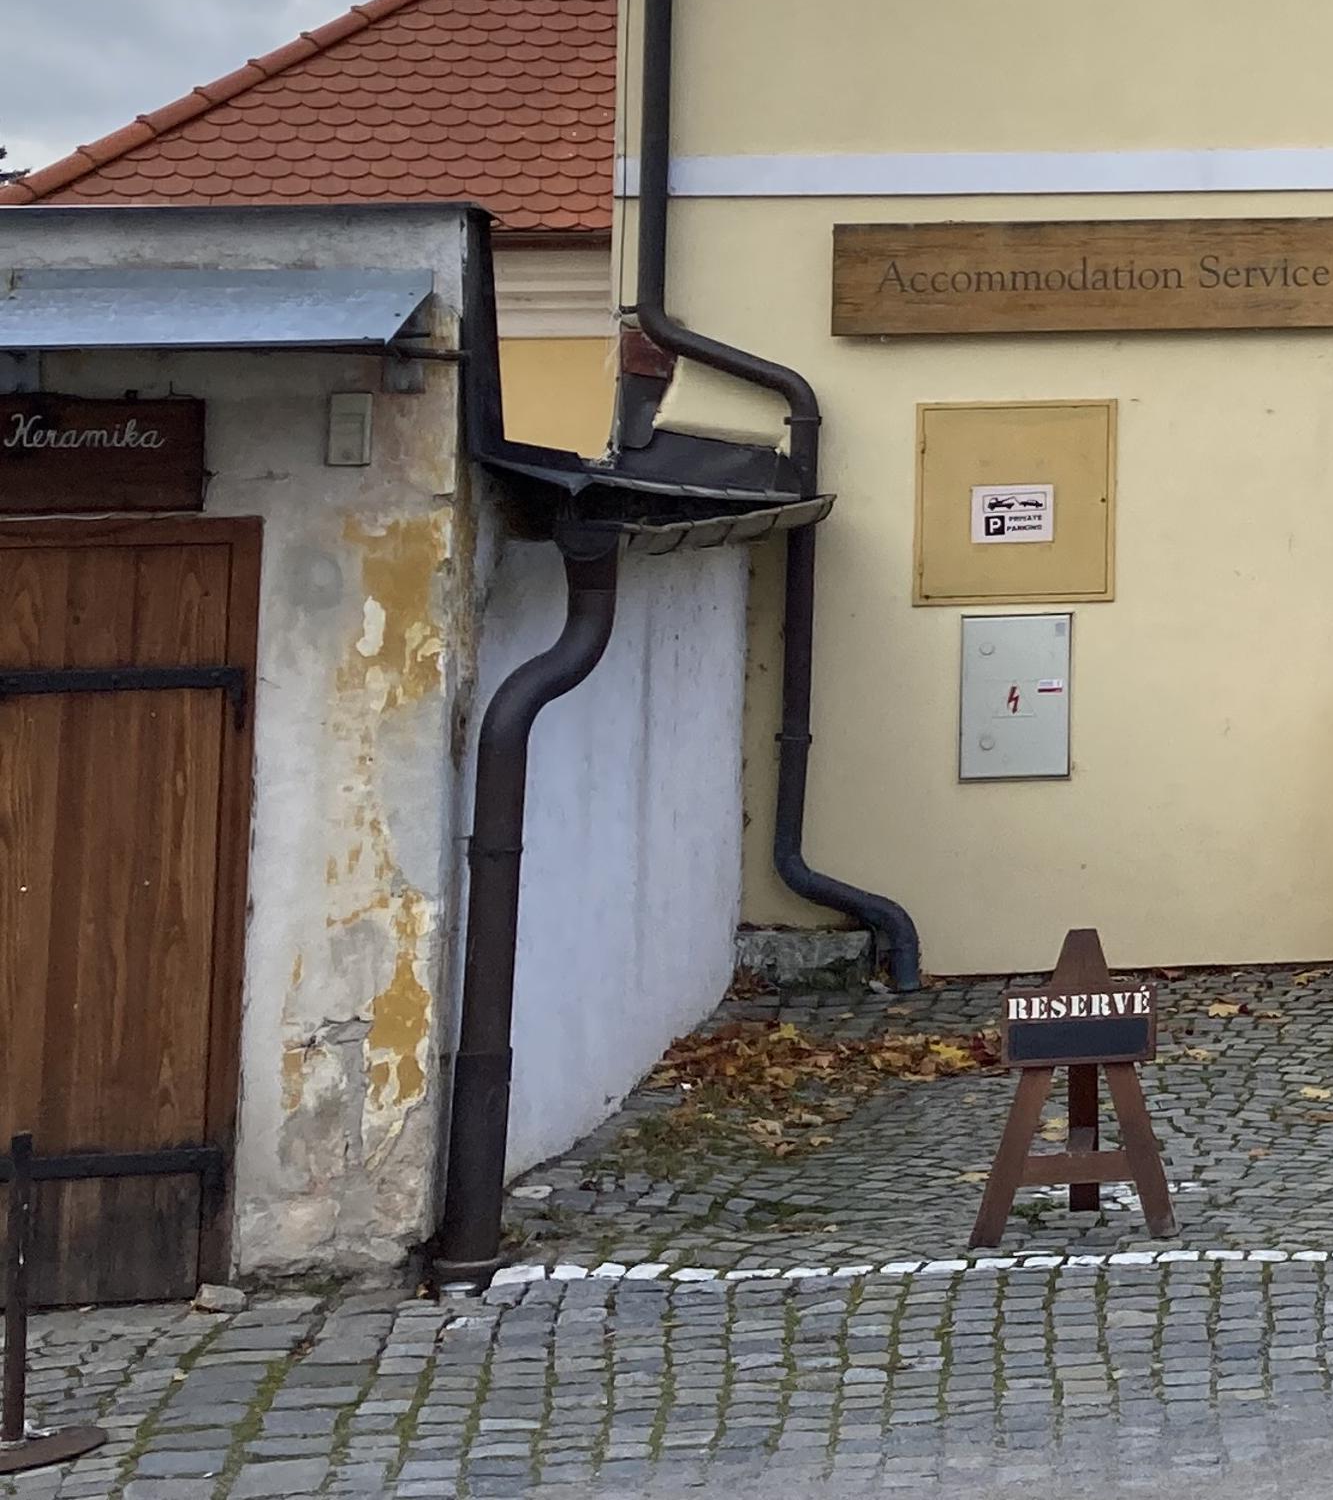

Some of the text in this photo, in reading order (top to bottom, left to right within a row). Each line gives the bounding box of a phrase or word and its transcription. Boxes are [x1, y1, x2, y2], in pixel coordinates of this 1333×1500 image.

[877, 255, 1331, 296] Accommodation Service
[3, 413, 166, 449] Keramika
[1007, 985, 1150, 1020] RESERVÉ
